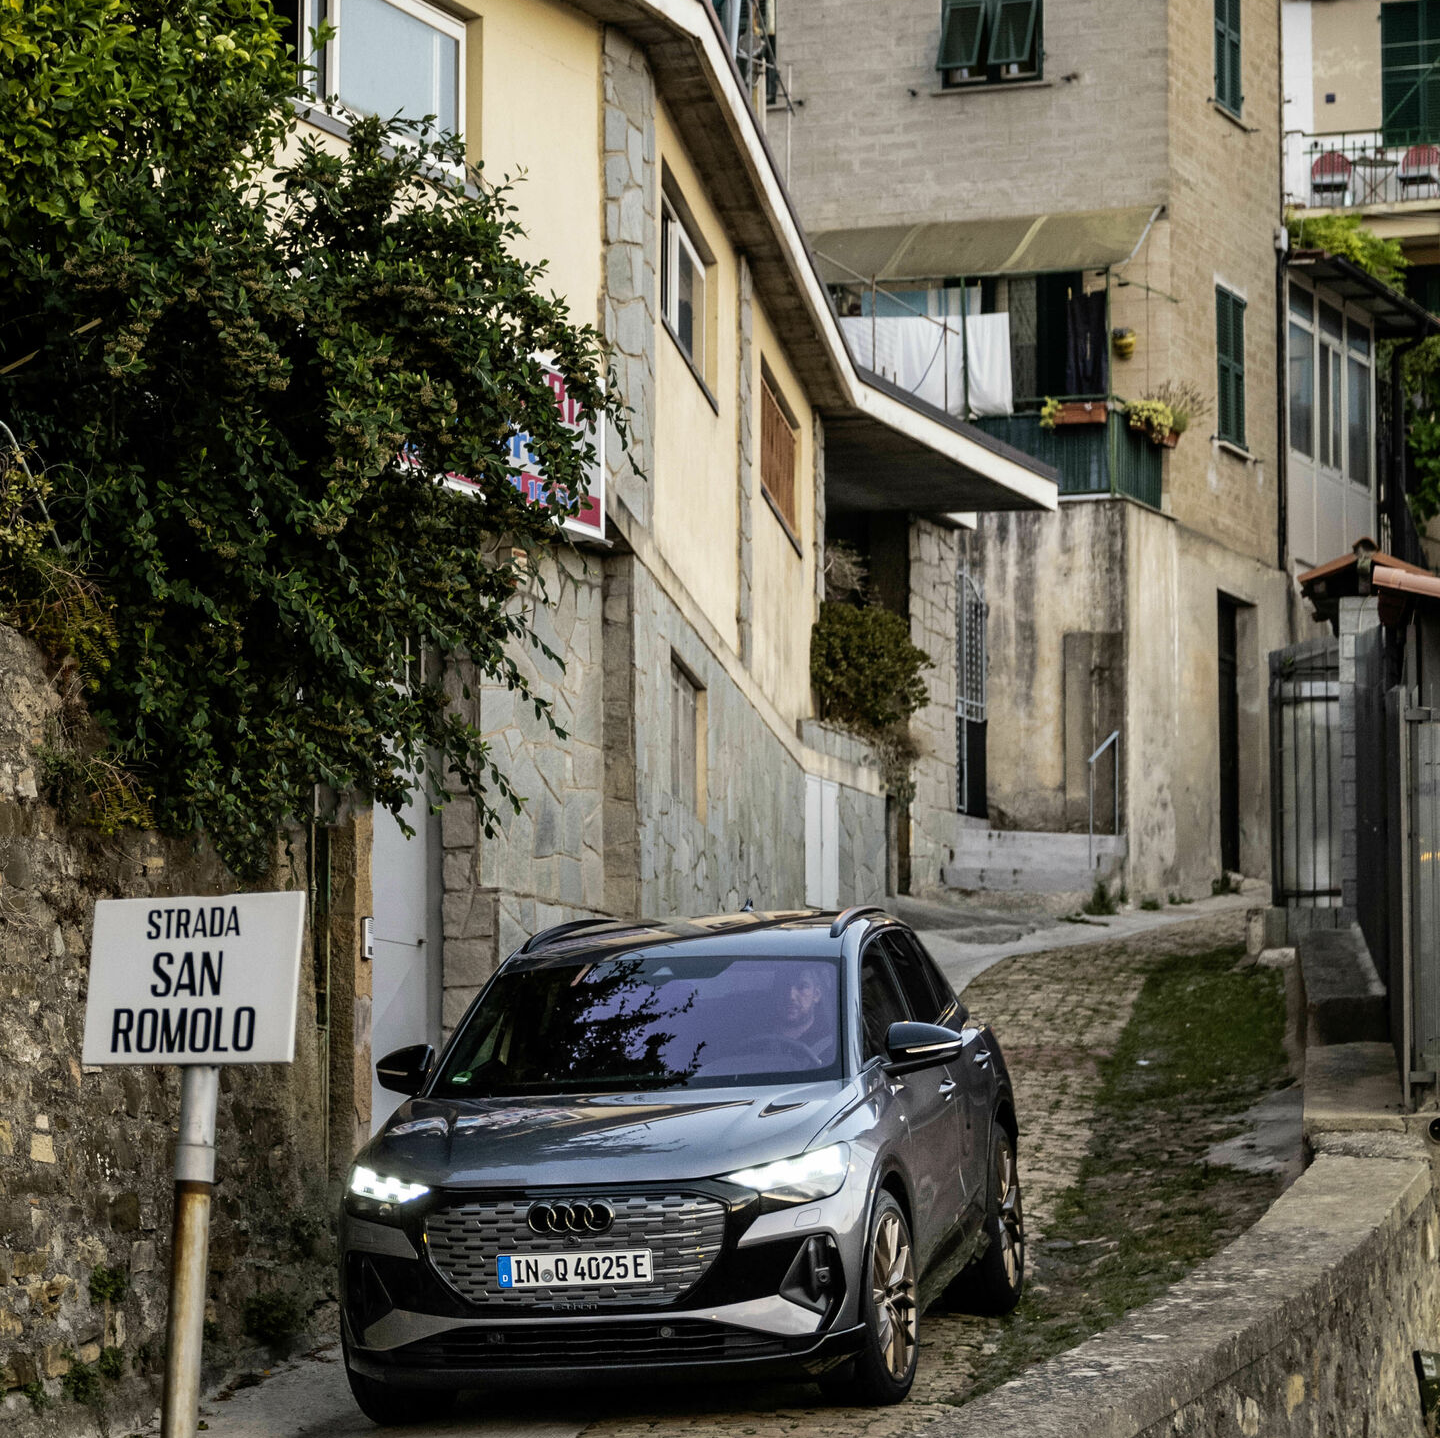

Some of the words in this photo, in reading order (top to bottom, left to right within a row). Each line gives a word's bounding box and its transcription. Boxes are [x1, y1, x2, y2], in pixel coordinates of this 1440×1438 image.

[146, 906, 241, 940] STRADA
[150, 950, 224, 998] SAN
[110, 1006, 256, 1054] ROMOLO
[502, 1274, 509, 1283] D
[514, 1259, 540, 1283] IN
[554, 1258, 568, 1281] Q
